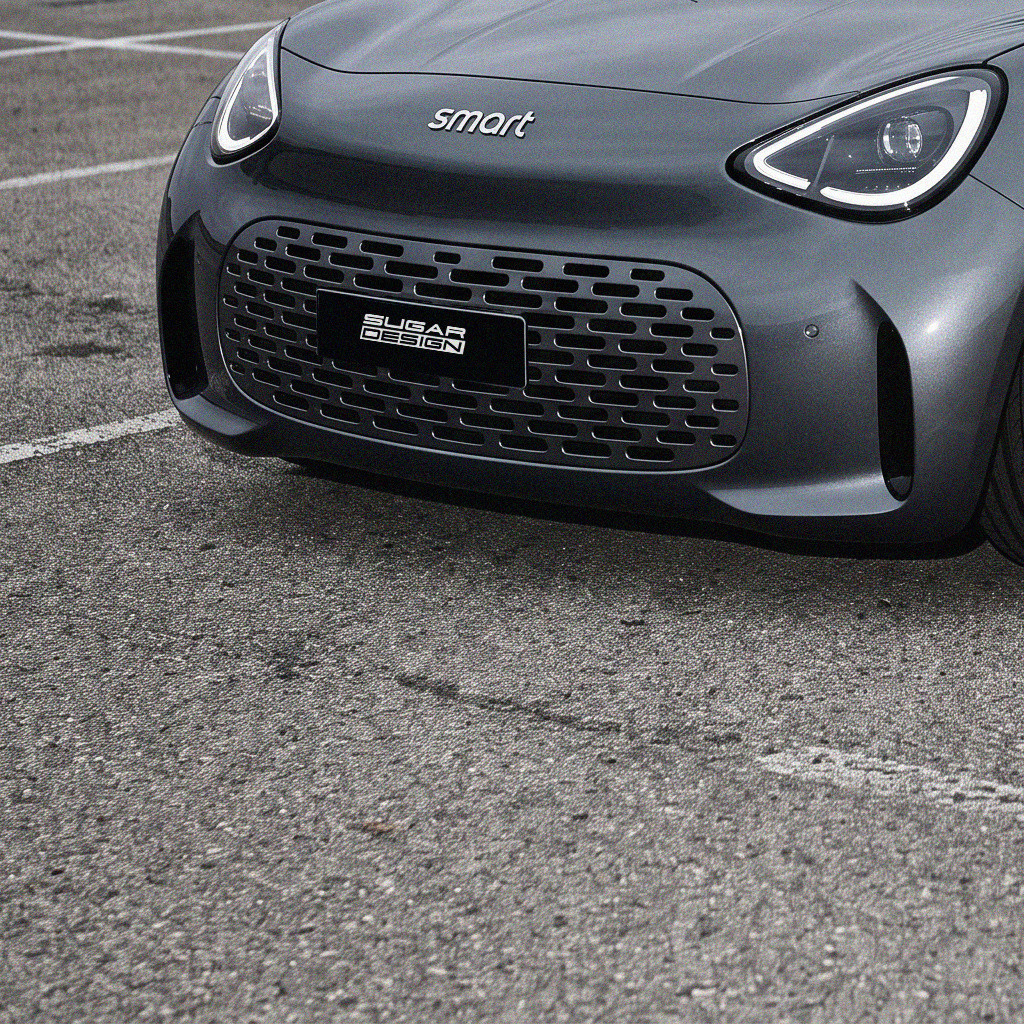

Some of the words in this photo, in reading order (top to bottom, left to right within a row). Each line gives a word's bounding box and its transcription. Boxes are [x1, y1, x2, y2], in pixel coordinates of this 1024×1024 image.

[427, 107, 536, 139] smart
[359, 325, 466, 355] DESIGN
[362, 313, 467, 339] SUGAR
